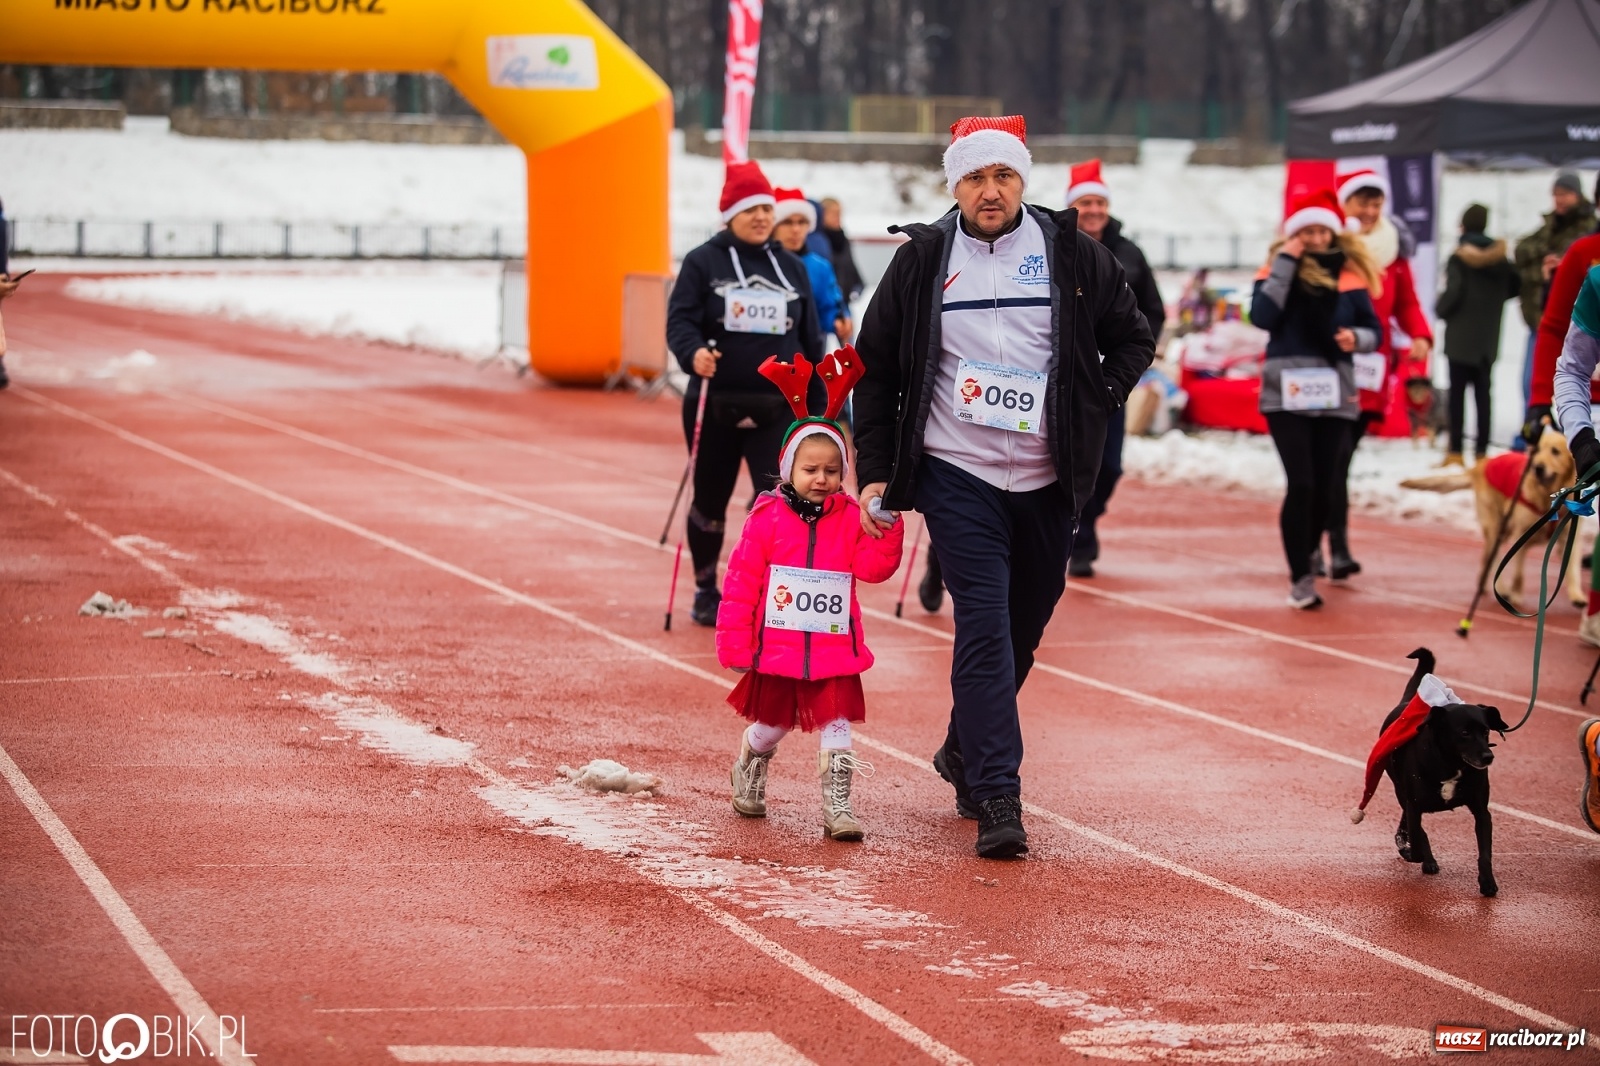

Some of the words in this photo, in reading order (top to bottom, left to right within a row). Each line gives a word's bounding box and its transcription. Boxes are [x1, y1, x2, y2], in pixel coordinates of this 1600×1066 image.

[1018, 261, 1044, 277] Gryf
[747, 304, 777, 319] 012
[985, 385, 1035, 412] 069
[796, 591, 843, 614] 068
